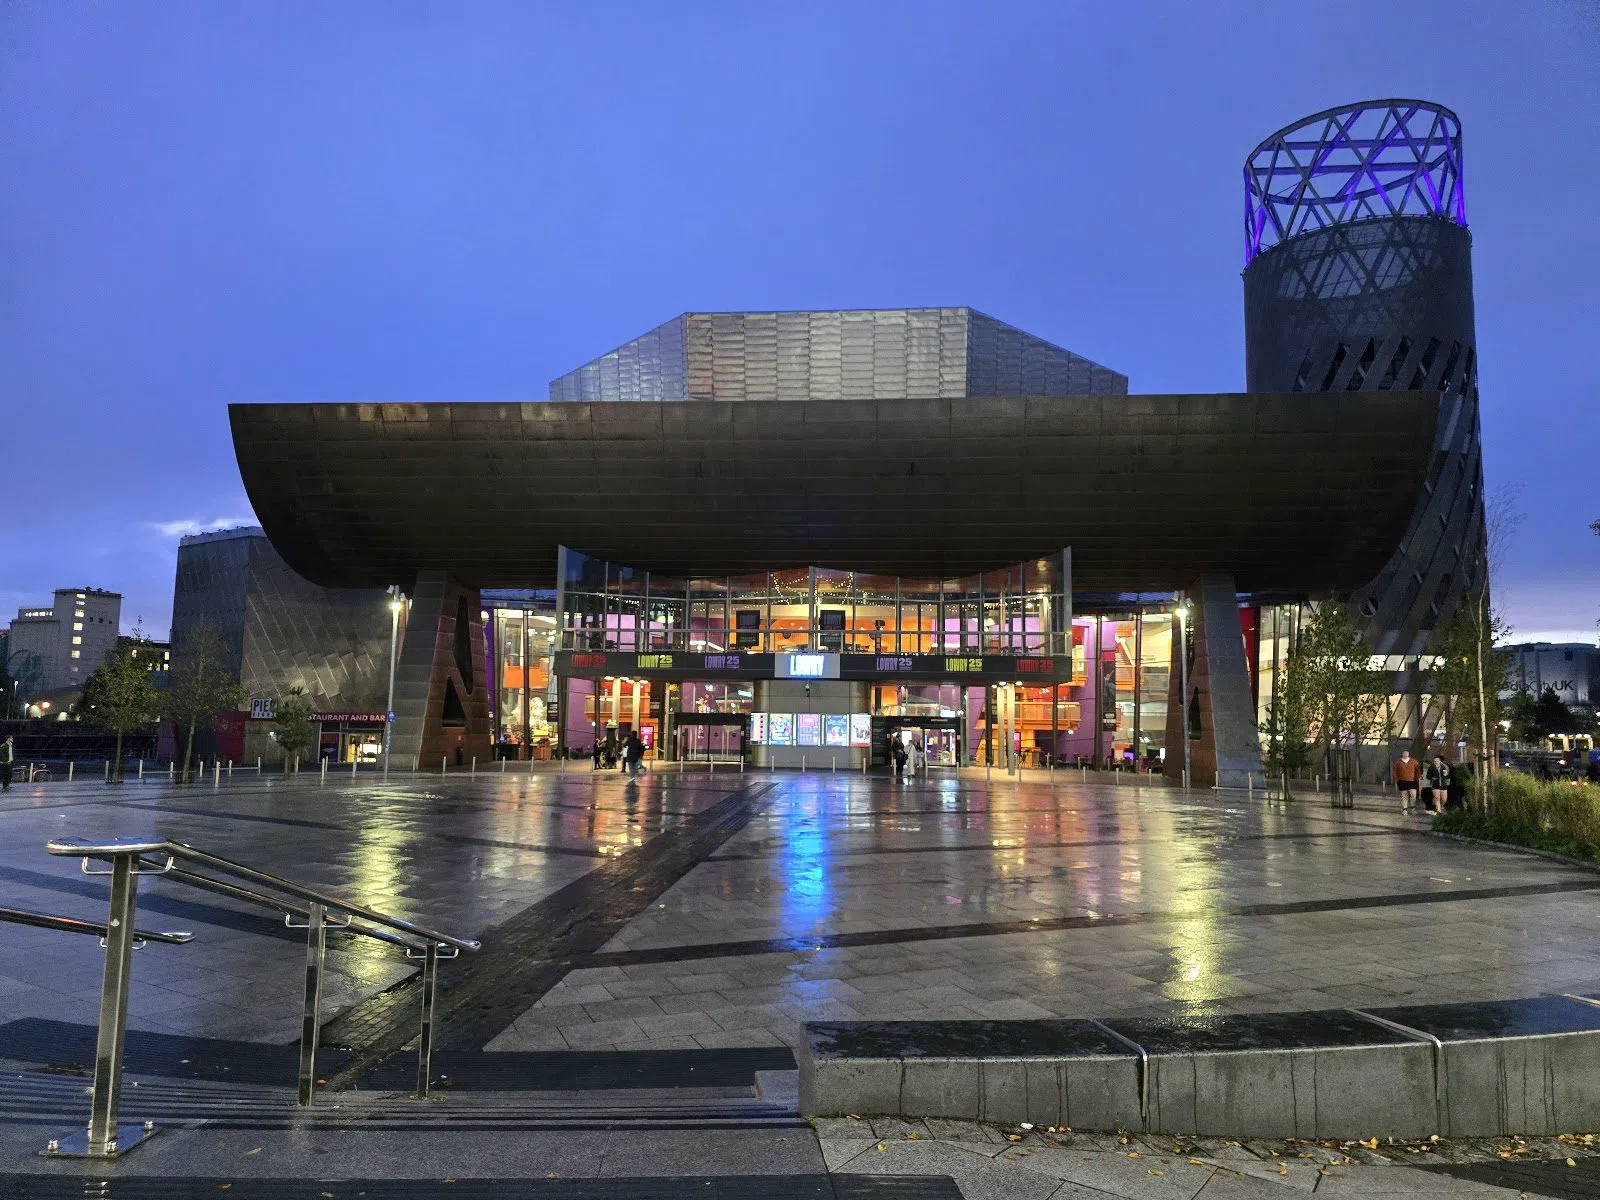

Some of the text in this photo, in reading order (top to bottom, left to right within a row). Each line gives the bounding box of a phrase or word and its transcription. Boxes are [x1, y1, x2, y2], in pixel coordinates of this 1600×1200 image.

[638, 655, 672, 668] LOWRY 25
[704, 656, 739, 668] LOWRY 25
[876, 657, 912, 670] LOWRY 25
[946, 658, 967, 672] LOWRY
[968, 658, 982, 667] 25
[1016, 660, 1039, 672] LOWRY
[369, 714, 386, 722] BAR
